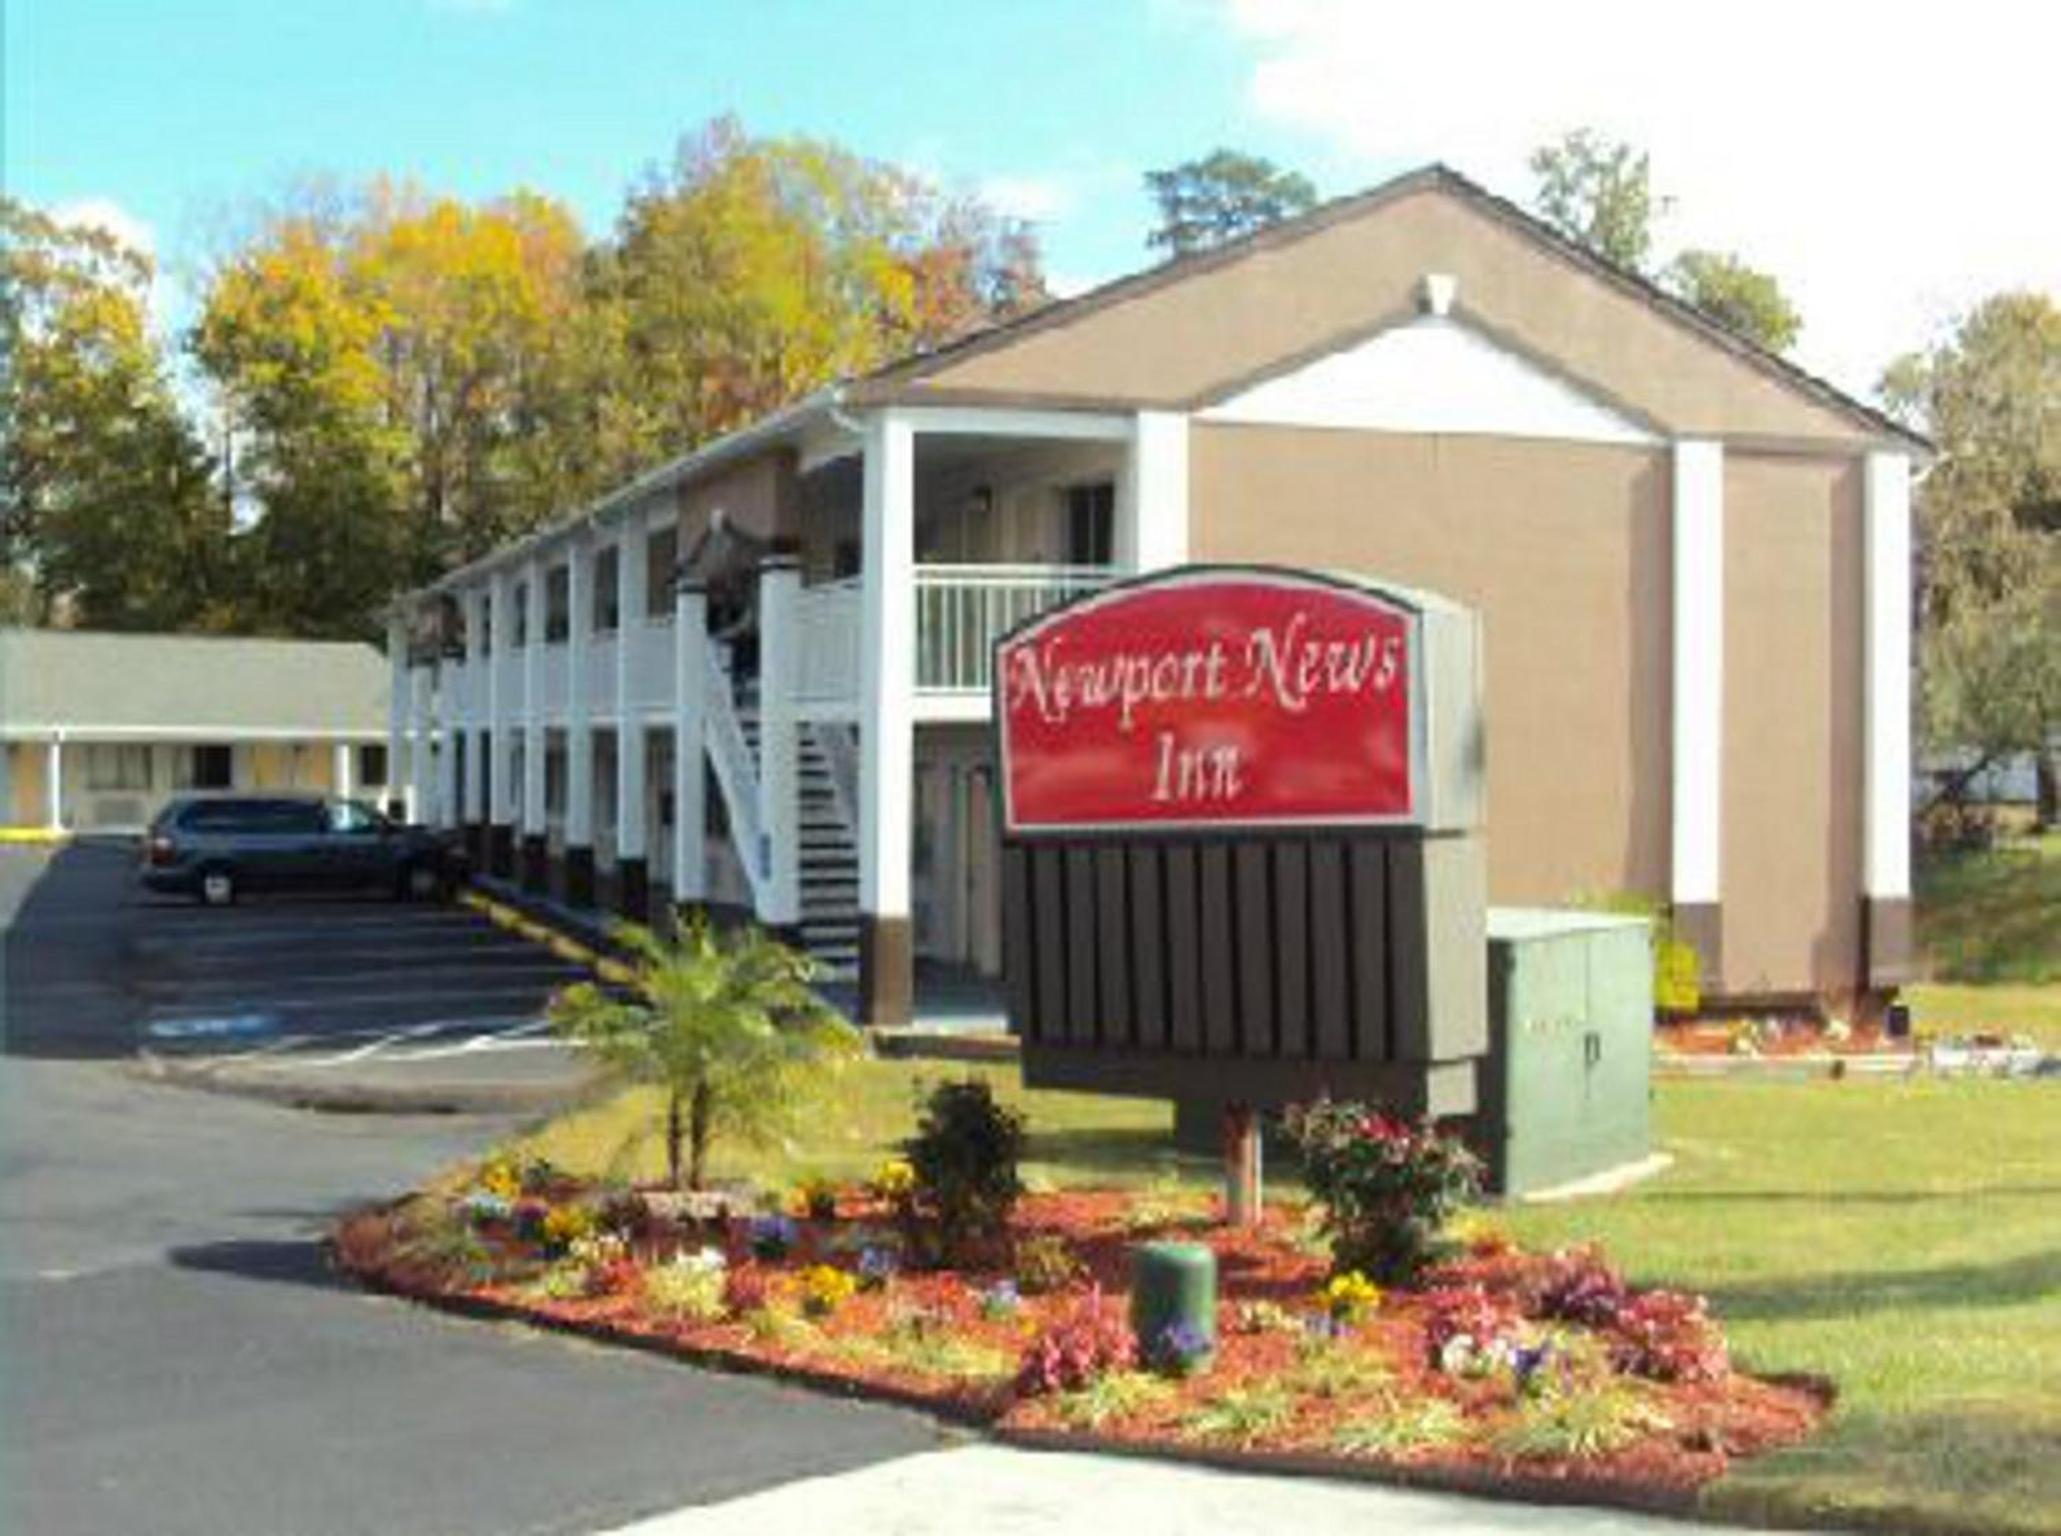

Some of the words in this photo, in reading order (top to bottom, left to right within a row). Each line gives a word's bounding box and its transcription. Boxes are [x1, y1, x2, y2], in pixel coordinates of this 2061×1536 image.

[1010, 636, 1228, 732] Newport
[1244, 612, 1401, 713] News
[1151, 732, 1244, 801] Inn
